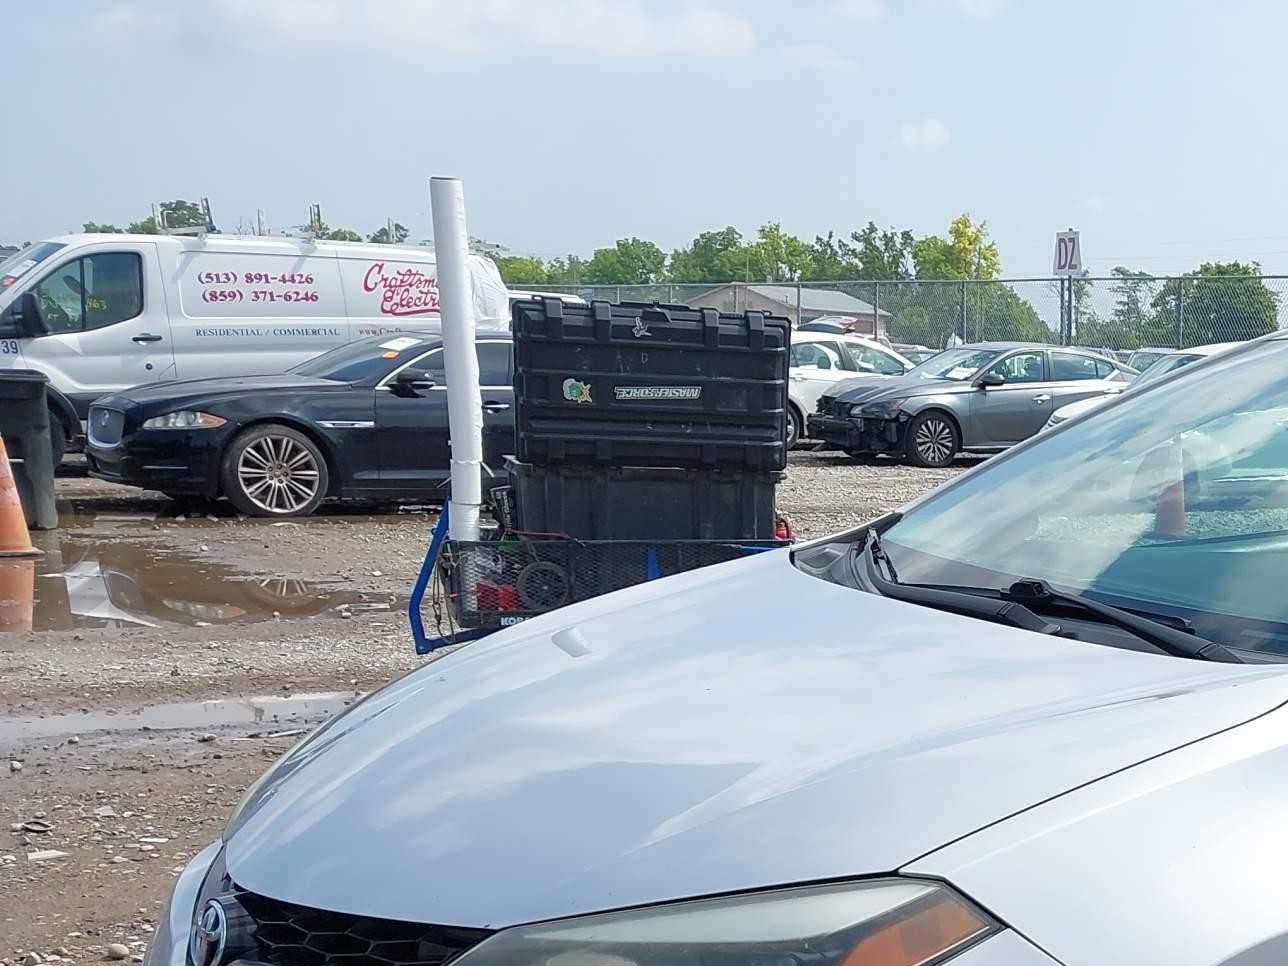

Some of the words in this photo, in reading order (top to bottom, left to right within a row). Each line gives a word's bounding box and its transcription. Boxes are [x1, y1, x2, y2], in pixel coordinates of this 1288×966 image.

[197, 271, 238, 285] (513)
[244, 272, 315, 285] 891-4426
[202, 289, 244, 303] (859)
[251, 290, 320, 303] 371-6246
[195, 328, 263, 337] RESIDENTIAL
[273, 327, 340, 337] COMMERCIAL
[1, 340, 19, 354] 39
[615, 387, 702, 400] MASTERFORCE
